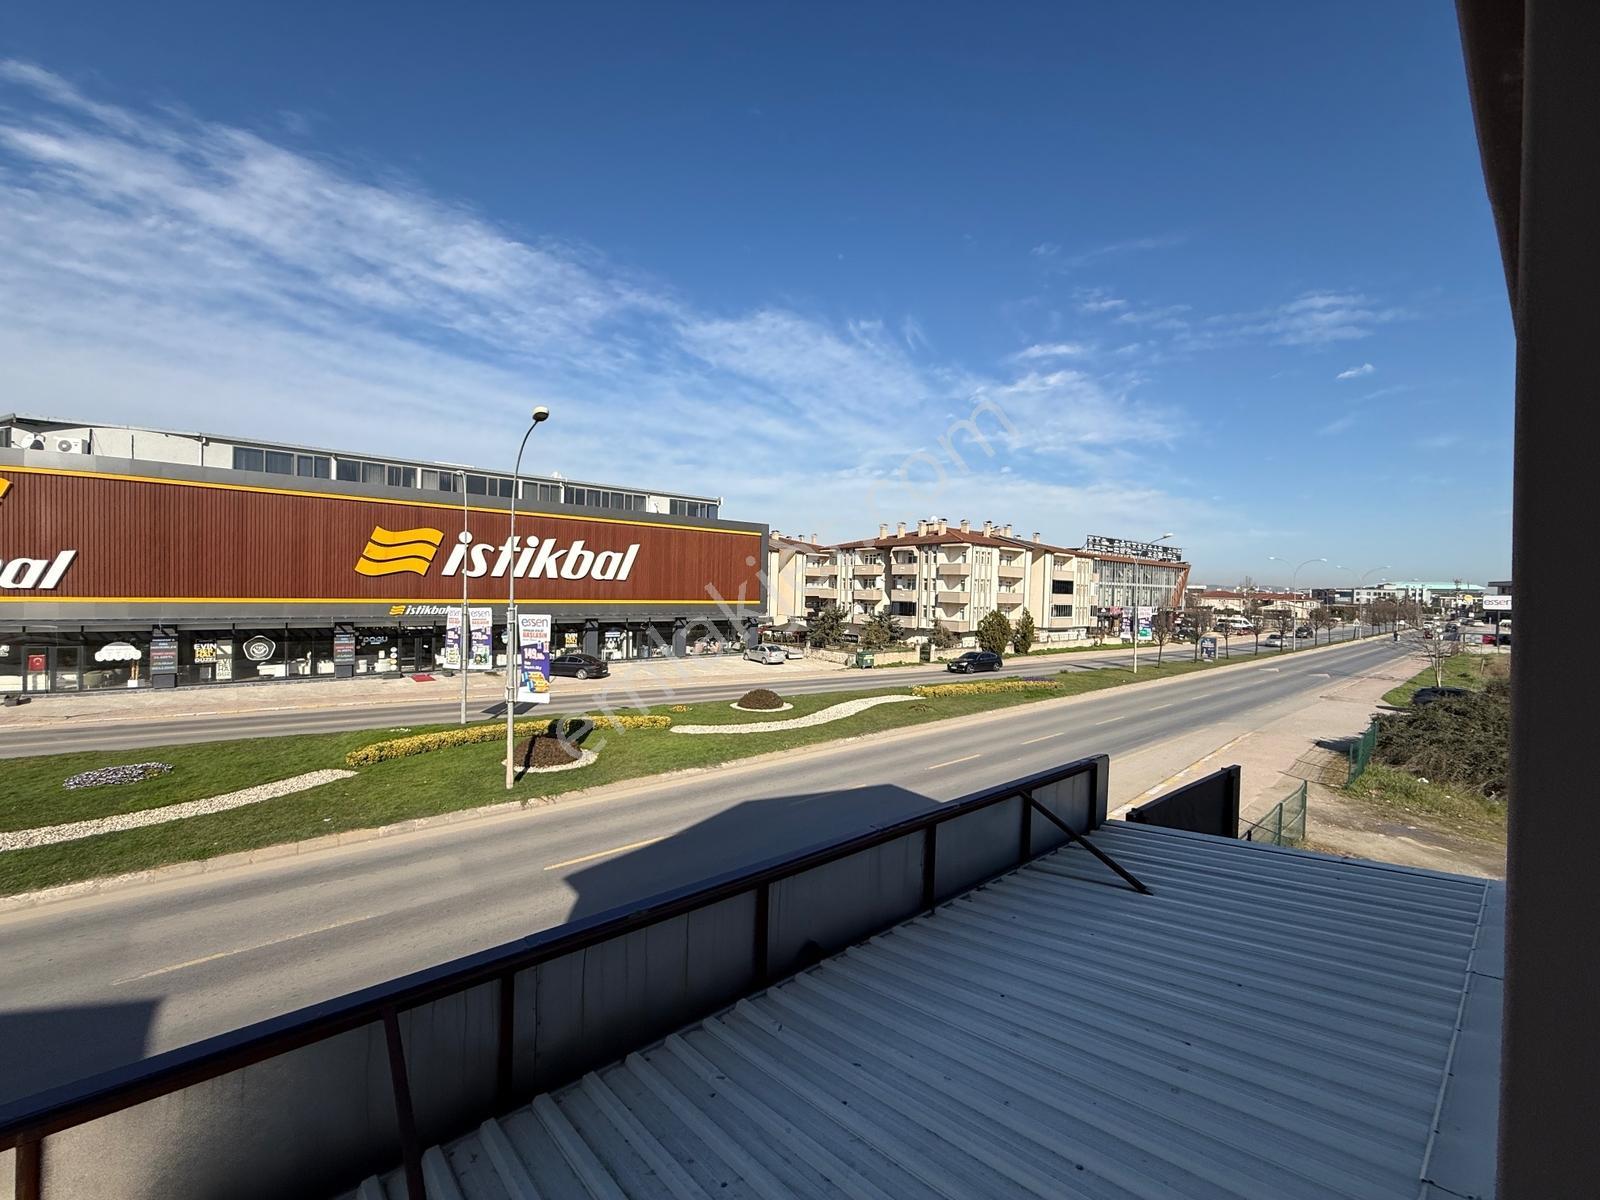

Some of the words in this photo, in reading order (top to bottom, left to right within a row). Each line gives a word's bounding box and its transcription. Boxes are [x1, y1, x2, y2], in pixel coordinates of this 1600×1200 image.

[441, 531, 641, 581] istikbal
[0, 549, 78, 590] al
[406, 605, 451, 616] istikbal
[521, 618, 549, 628] essen
